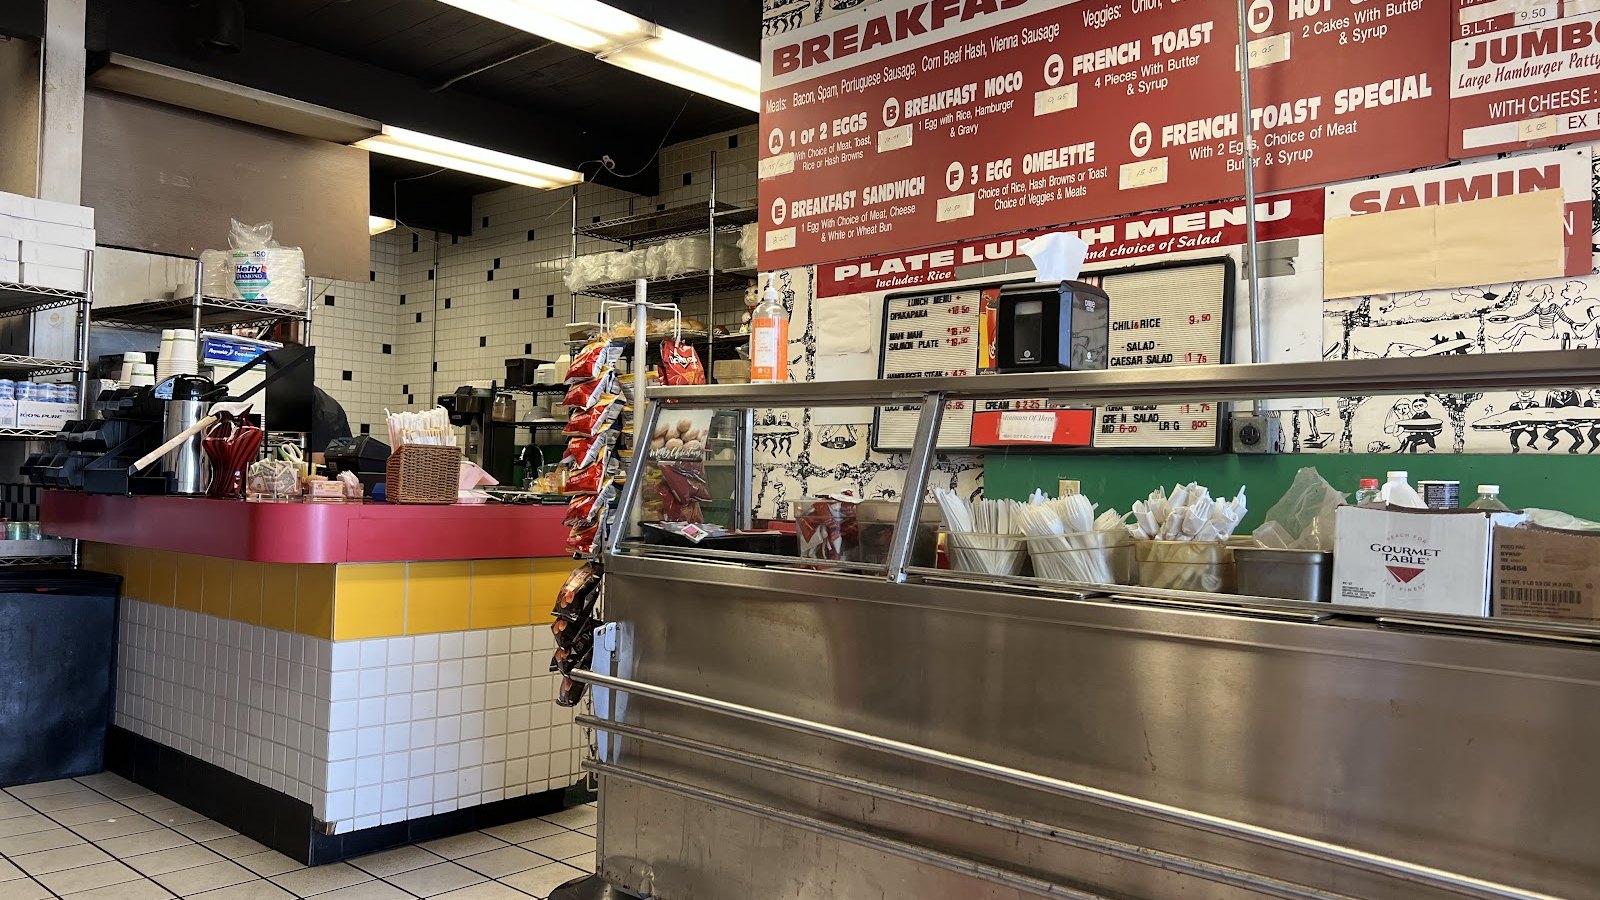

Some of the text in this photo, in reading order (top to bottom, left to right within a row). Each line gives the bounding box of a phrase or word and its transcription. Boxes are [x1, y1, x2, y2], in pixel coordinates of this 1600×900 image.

[1288, 0, 1331, 21] HOT
[1302, 0, 1423, 38] 2 Cakes With Butter
[1521, 7, 1546, 20] 9.50
[1339, 24, 1388, 45] & Syrup
[1461, 19, 1498, 36] B.L.T.
[1072, 21, 1214, 77] FRENCH TOAST
[1467, 20, 1600, 69] JUMB
[766, 98, 786, 114] Meats:
[793, 91, 815, 107] Bacon,
[817, 85, 838, 104] Spam,
[841, 73, 880, 94] Portuguese
[883, 62, 917, 83] Sausage,
[922, 55, 940, 72] Corn
[944, 48, 962, 66] Beef
[964, 40, 987, 61] Hash,
[991, 35, 1018, 52] Vienna
[1022, 23, 1060, 45] Sausage
[1083, 4, 1121, 29] Veggies:
[1094, 54, 1200, 88] 4 Pieces With Butter
[1126, 77, 1168, 96] & Syrup
[1458, 73, 1491, 90] Large
[1495, 60, 1563, 82] Hamburger
[904, 83, 977, 118] BREAKFAST
[984, 70, 1023, 98] MOCO
[1489, 87, 1590, 119] WITH CHEESE
[918, 100, 1014, 131] 1 Egg with Rice, Hamburger
[1162, 112, 1238, 148] FRENCH
[1250, 96, 1321, 131] TOAST
[1334, 72, 1432, 115] SPECIAL
[1568, 114, 1587, 129] EX
[790, 130, 796, 147] 1
[801, 128, 815, 144] or
[819, 122, 828, 140] 2
[832, 111, 867, 137] EGGS
[949, 123, 979, 137] & Gravy
[1189, 120, 1357, 160] With 2 Egs, Choice of Meat
[808, 146, 827, 158] Choice
[829, 144, 835, 154] of
[837, 140, 852, 152] Meat,
[855, 135, 872, 148] Toast,
[803, 161, 814, 171] Rice
[817, 160, 823, 168] or
[825, 155, 839, 166] Hash
[841, 150, 864, 163] Browns
[970, 164, 979, 185] 3
[986, 158, 1012, 182] EGG
[1022, 141, 1095, 175] OMELETTE
[1226, 147, 1313, 172] Buter & Syrup
[977, 166, 1108, 200] Choice of Rice, Hash Browns or Toast
[1349, 163, 1560, 216] SAIMIN
[791, 190, 856, 219] BREAKFAST
[862, 176, 925, 206] SANDWICH
[994, 185, 1087, 211] Choice of Veggies & Meats
[807, 221, 819, 234] Egg
[821, 217, 835, 229] With
[837, 214, 859, 227] Choice
[861, 211, 868, 222] of
[869, 209, 887, 221] Meat,
[889, 204, 916, 217] Cheese
[820, 222, 892, 242] & White or Wheat Bun
[834, 200, 1291, 281] PLATE MENU
[236, 265, 261, 273] Hefty
[875, 231, 1223, 288] Includes: Rice choice of Salad
[907, 294, 952, 307] LUNCH MENU
[890, 309, 928, 320] OPAKAPAKA
[889, 340, 939, 350] SALMON PLATE
[1126, 341, 1155, 351] SALAD
[1110, 354, 1173, 366] CAESAR SALAD
[985, 401, 1010, 409] CREAM
[1133, 413, 1159, 423] SALAD
[1387, 533, 1410, 541] REACH
[1370, 543, 1441, 557] GOURMET
[1382, 553, 1426, 565] TABLE
